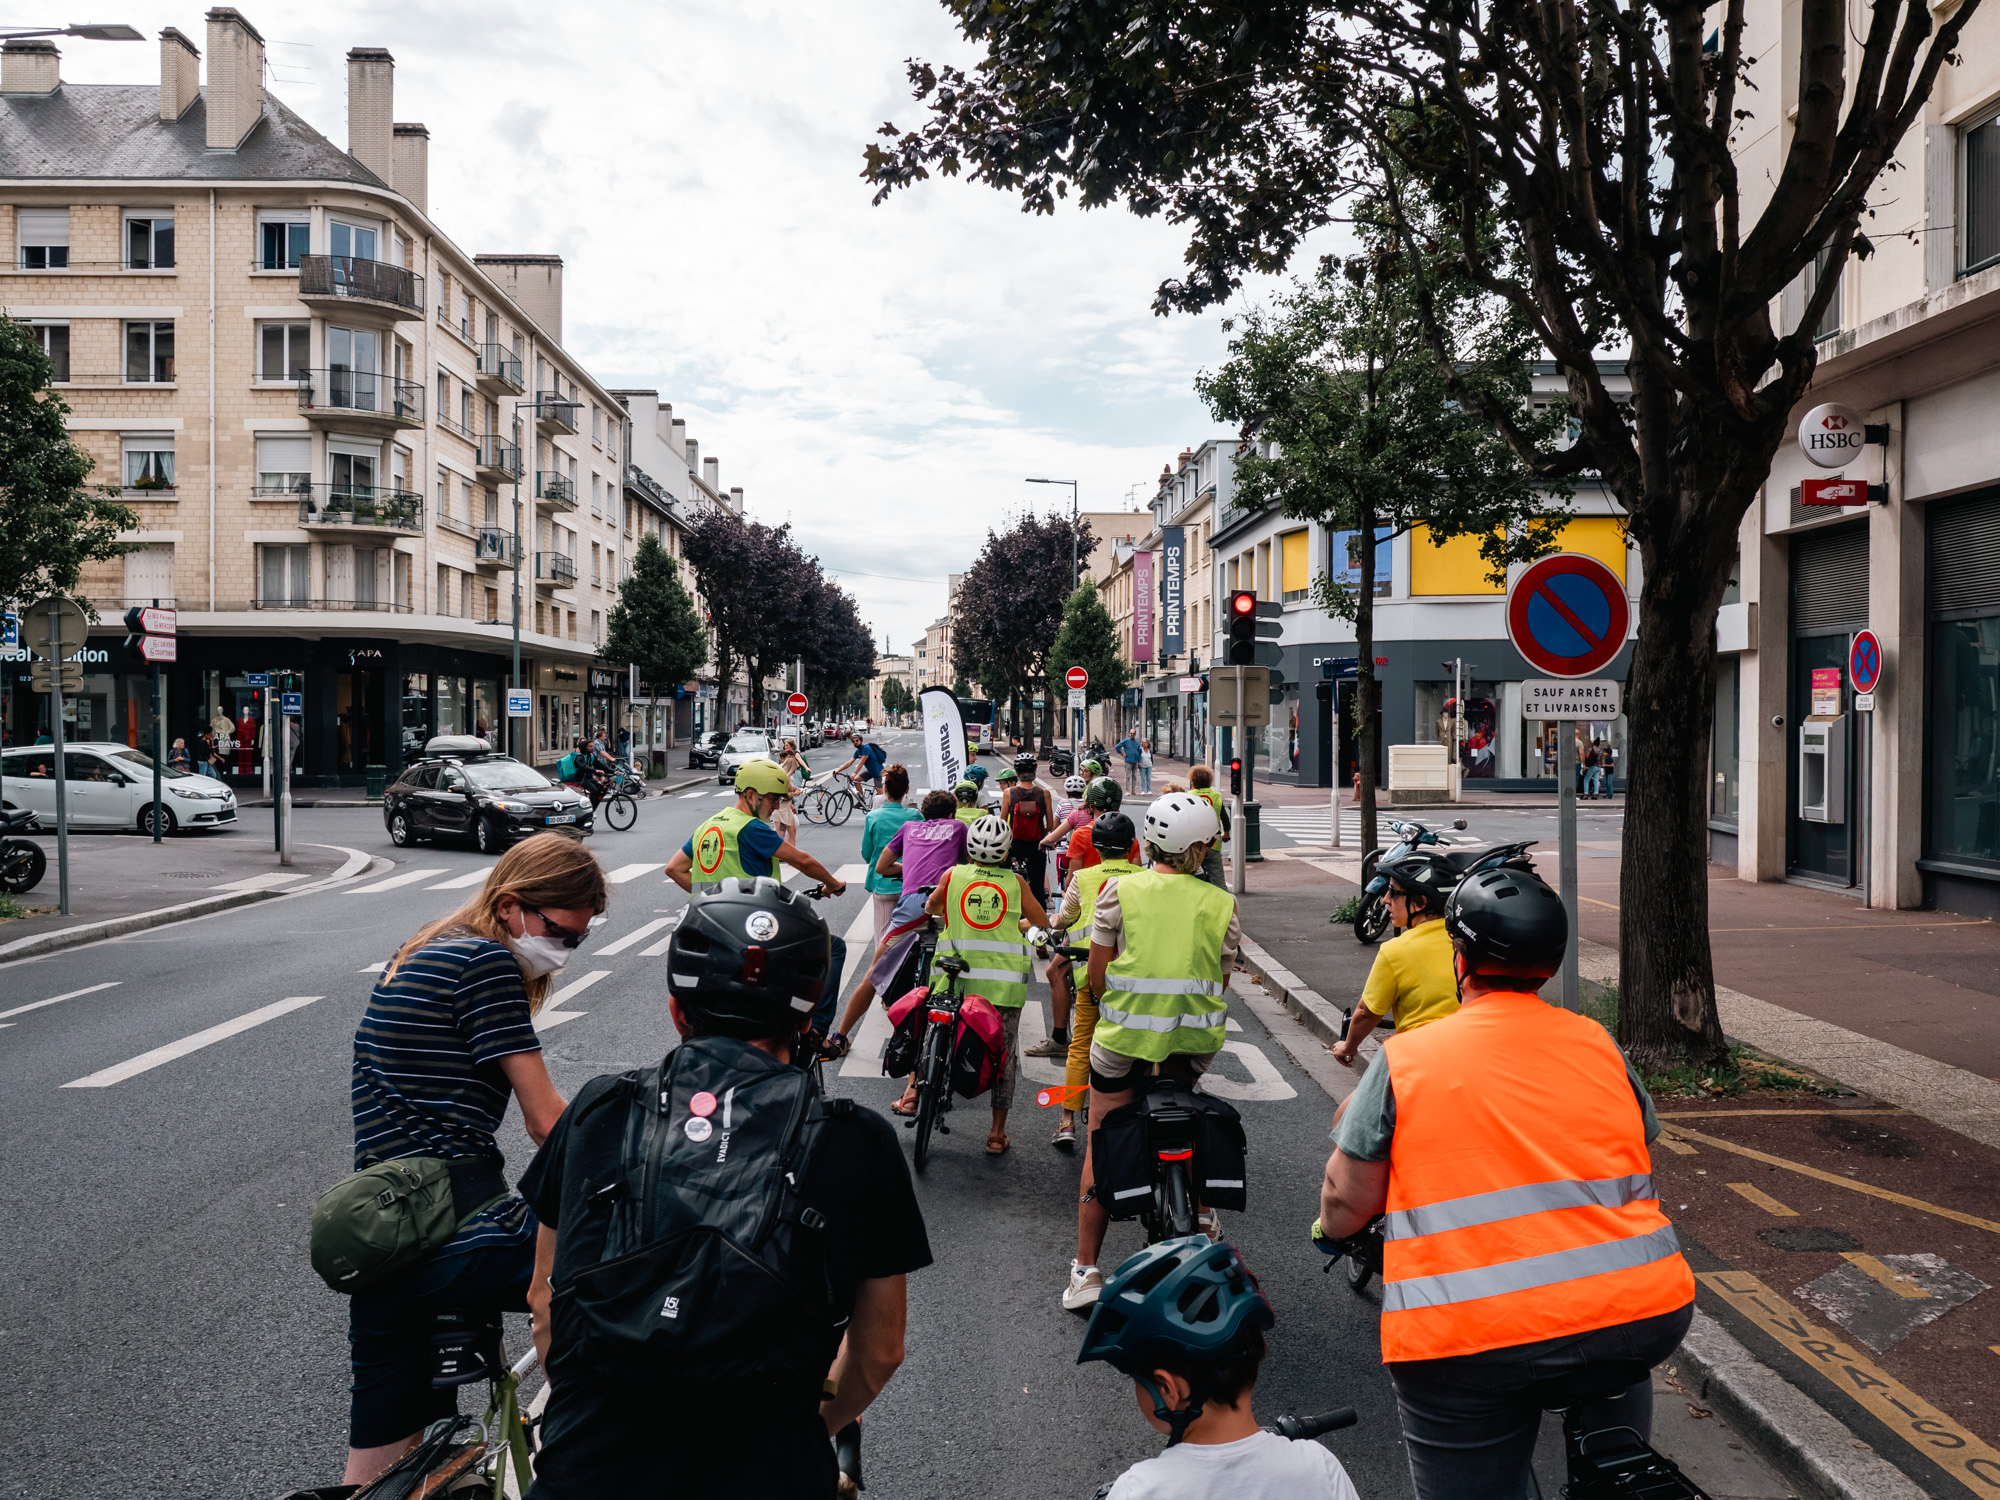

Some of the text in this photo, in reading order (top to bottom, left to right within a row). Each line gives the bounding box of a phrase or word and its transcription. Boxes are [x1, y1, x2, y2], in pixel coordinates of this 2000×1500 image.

[1810, 432, 1860, 449] HSBC
[1167, 546, 1180, 636] PRINTEMPS
[1137, 568, 1149, 645] PRINTEMPS
[348, 649, 382, 658] ZAPA
[1374, 657, 1388, 665] 1902
[1534, 687, 1608, 697] SAUF ARRÊT
[1526, 704, 1616, 713] ET LIVRAISONS
[218, 740, 241, 748] DAYS
[716, 1132, 730, 1162] EVADICT
